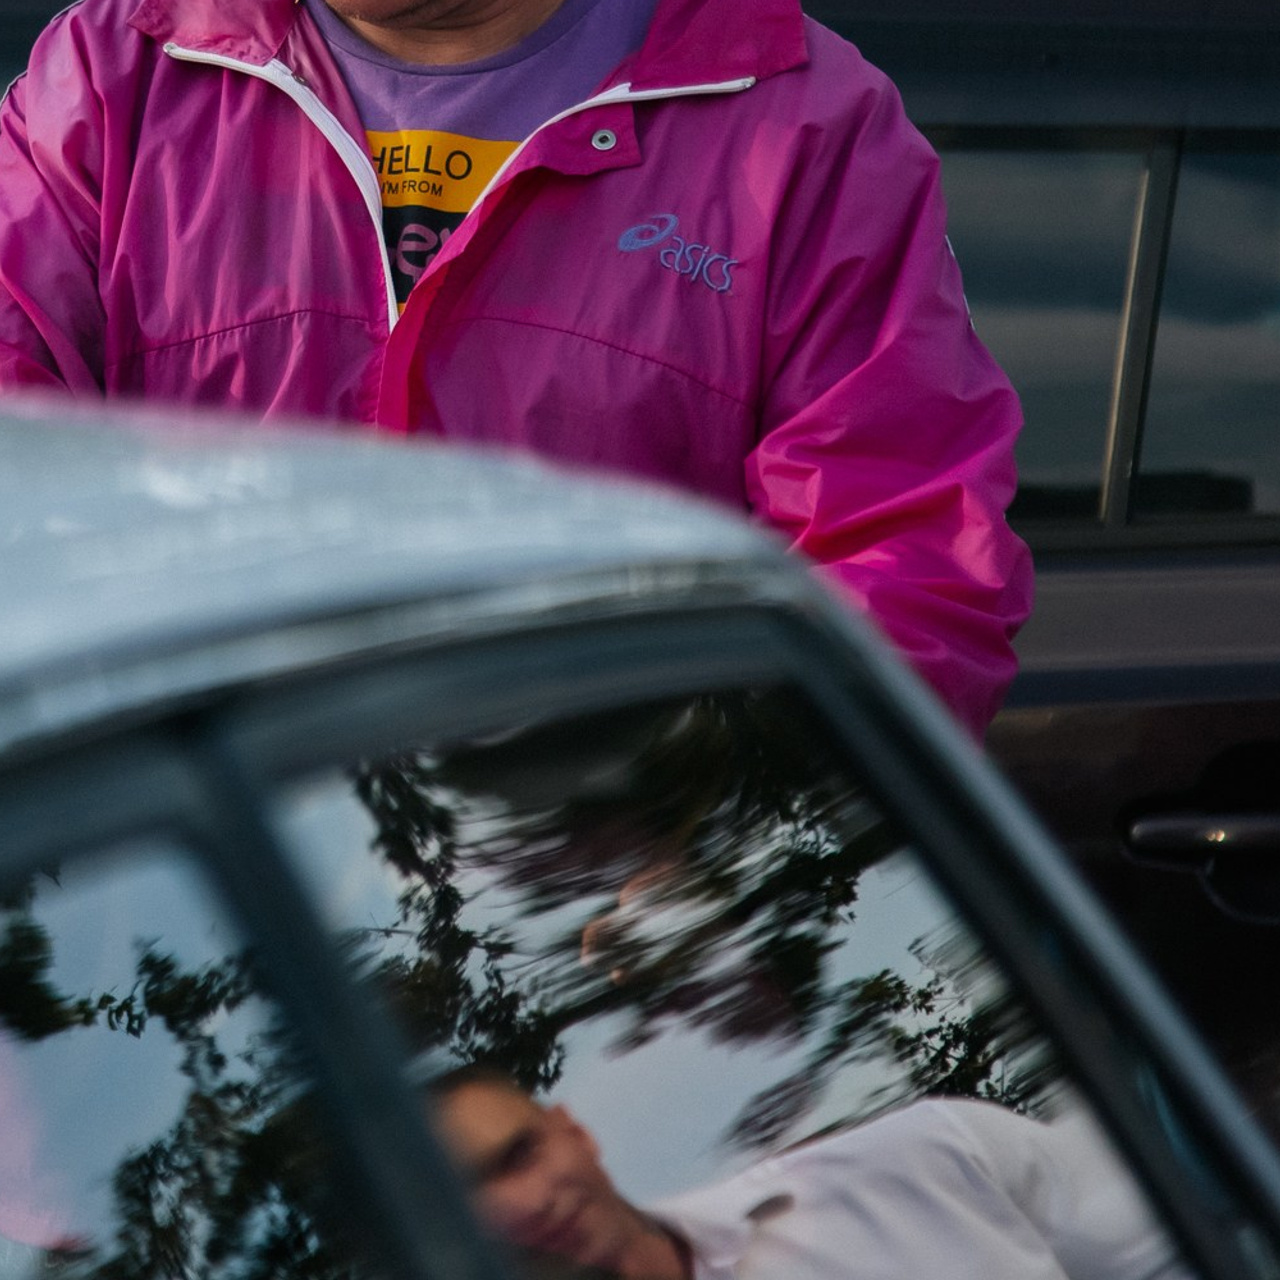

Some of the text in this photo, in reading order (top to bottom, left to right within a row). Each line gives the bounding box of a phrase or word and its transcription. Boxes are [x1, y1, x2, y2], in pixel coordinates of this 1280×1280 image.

[372, 144, 472, 180] HELLO
[402, 180, 443, 197] FROM
[660, 236, 738, 292] asics
